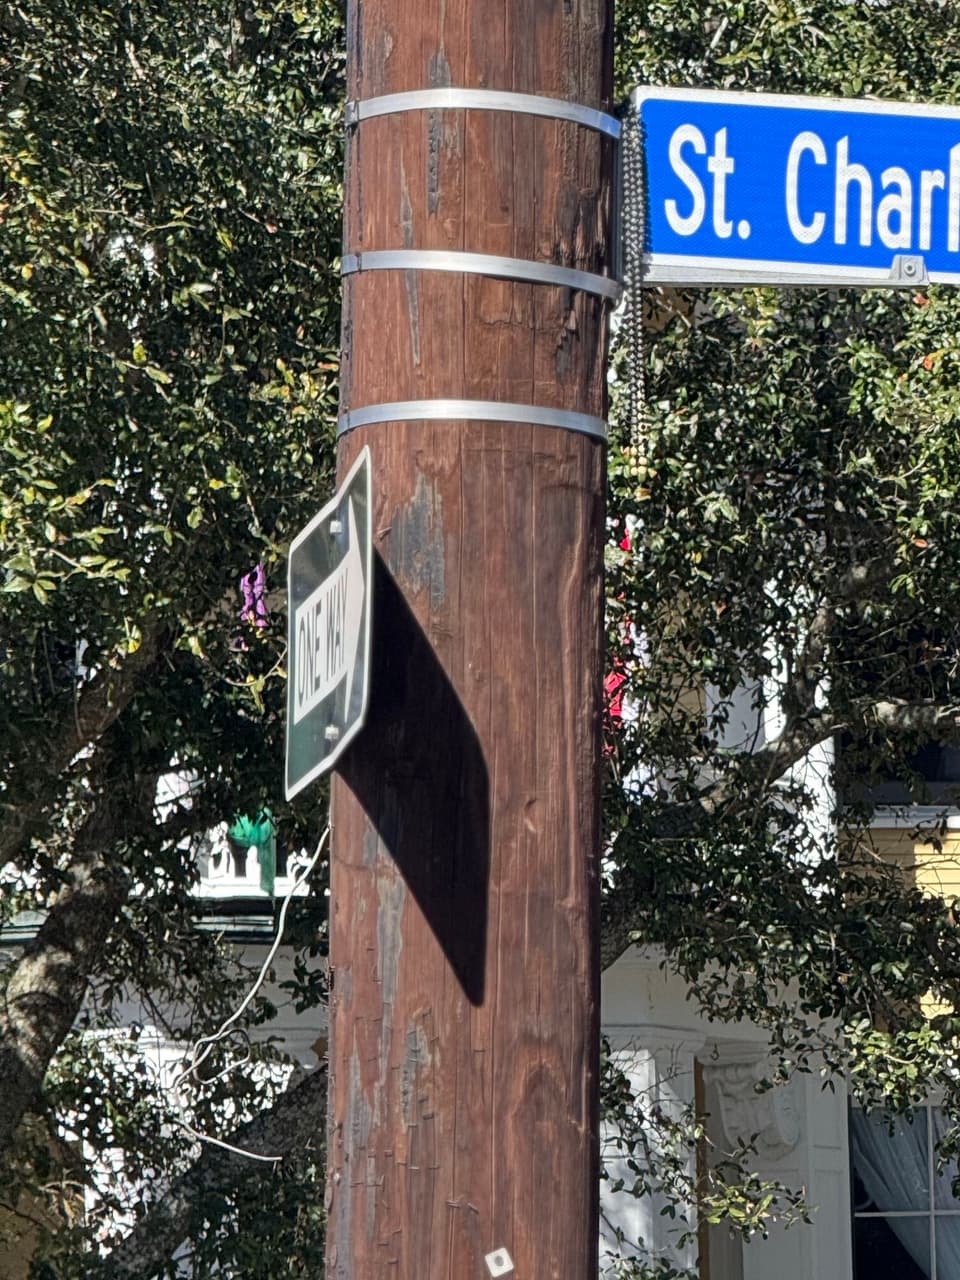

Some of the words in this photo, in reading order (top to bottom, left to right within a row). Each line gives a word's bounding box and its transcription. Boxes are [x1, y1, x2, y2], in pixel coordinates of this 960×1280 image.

[664, 123, 751, 240] St.
[298, 599, 322, 708] ONE
[326, 567, 348, 682] WAY
